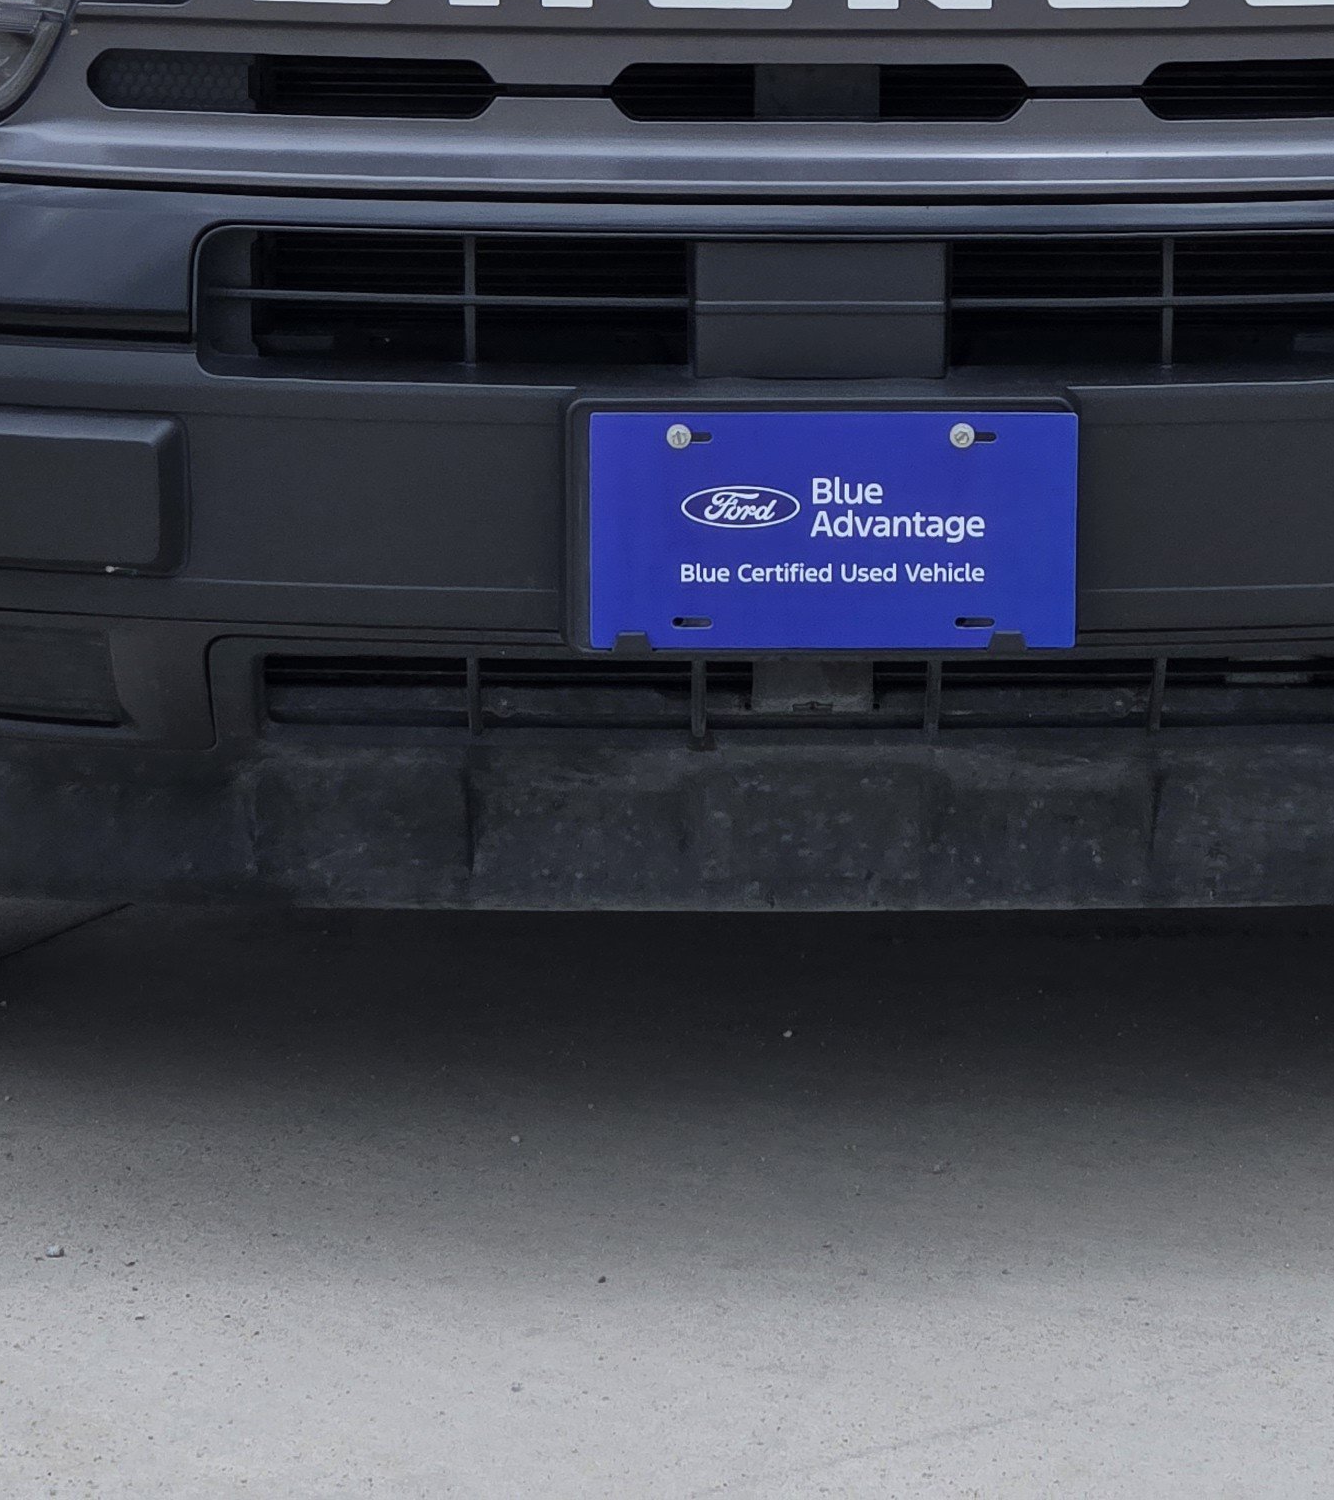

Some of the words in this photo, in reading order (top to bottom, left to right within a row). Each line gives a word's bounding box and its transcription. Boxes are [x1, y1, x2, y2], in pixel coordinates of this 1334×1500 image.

[702, 490, 778, 522] Ford
[811, 477, 884, 505] Blue
[810, 509, 986, 543] Advantage
[679, 563, 730, 583] Blue
[736, 562, 833, 583] Certified
[840, 563, 897, 583] Used
[904, 562, 985, 583] Vehicle
